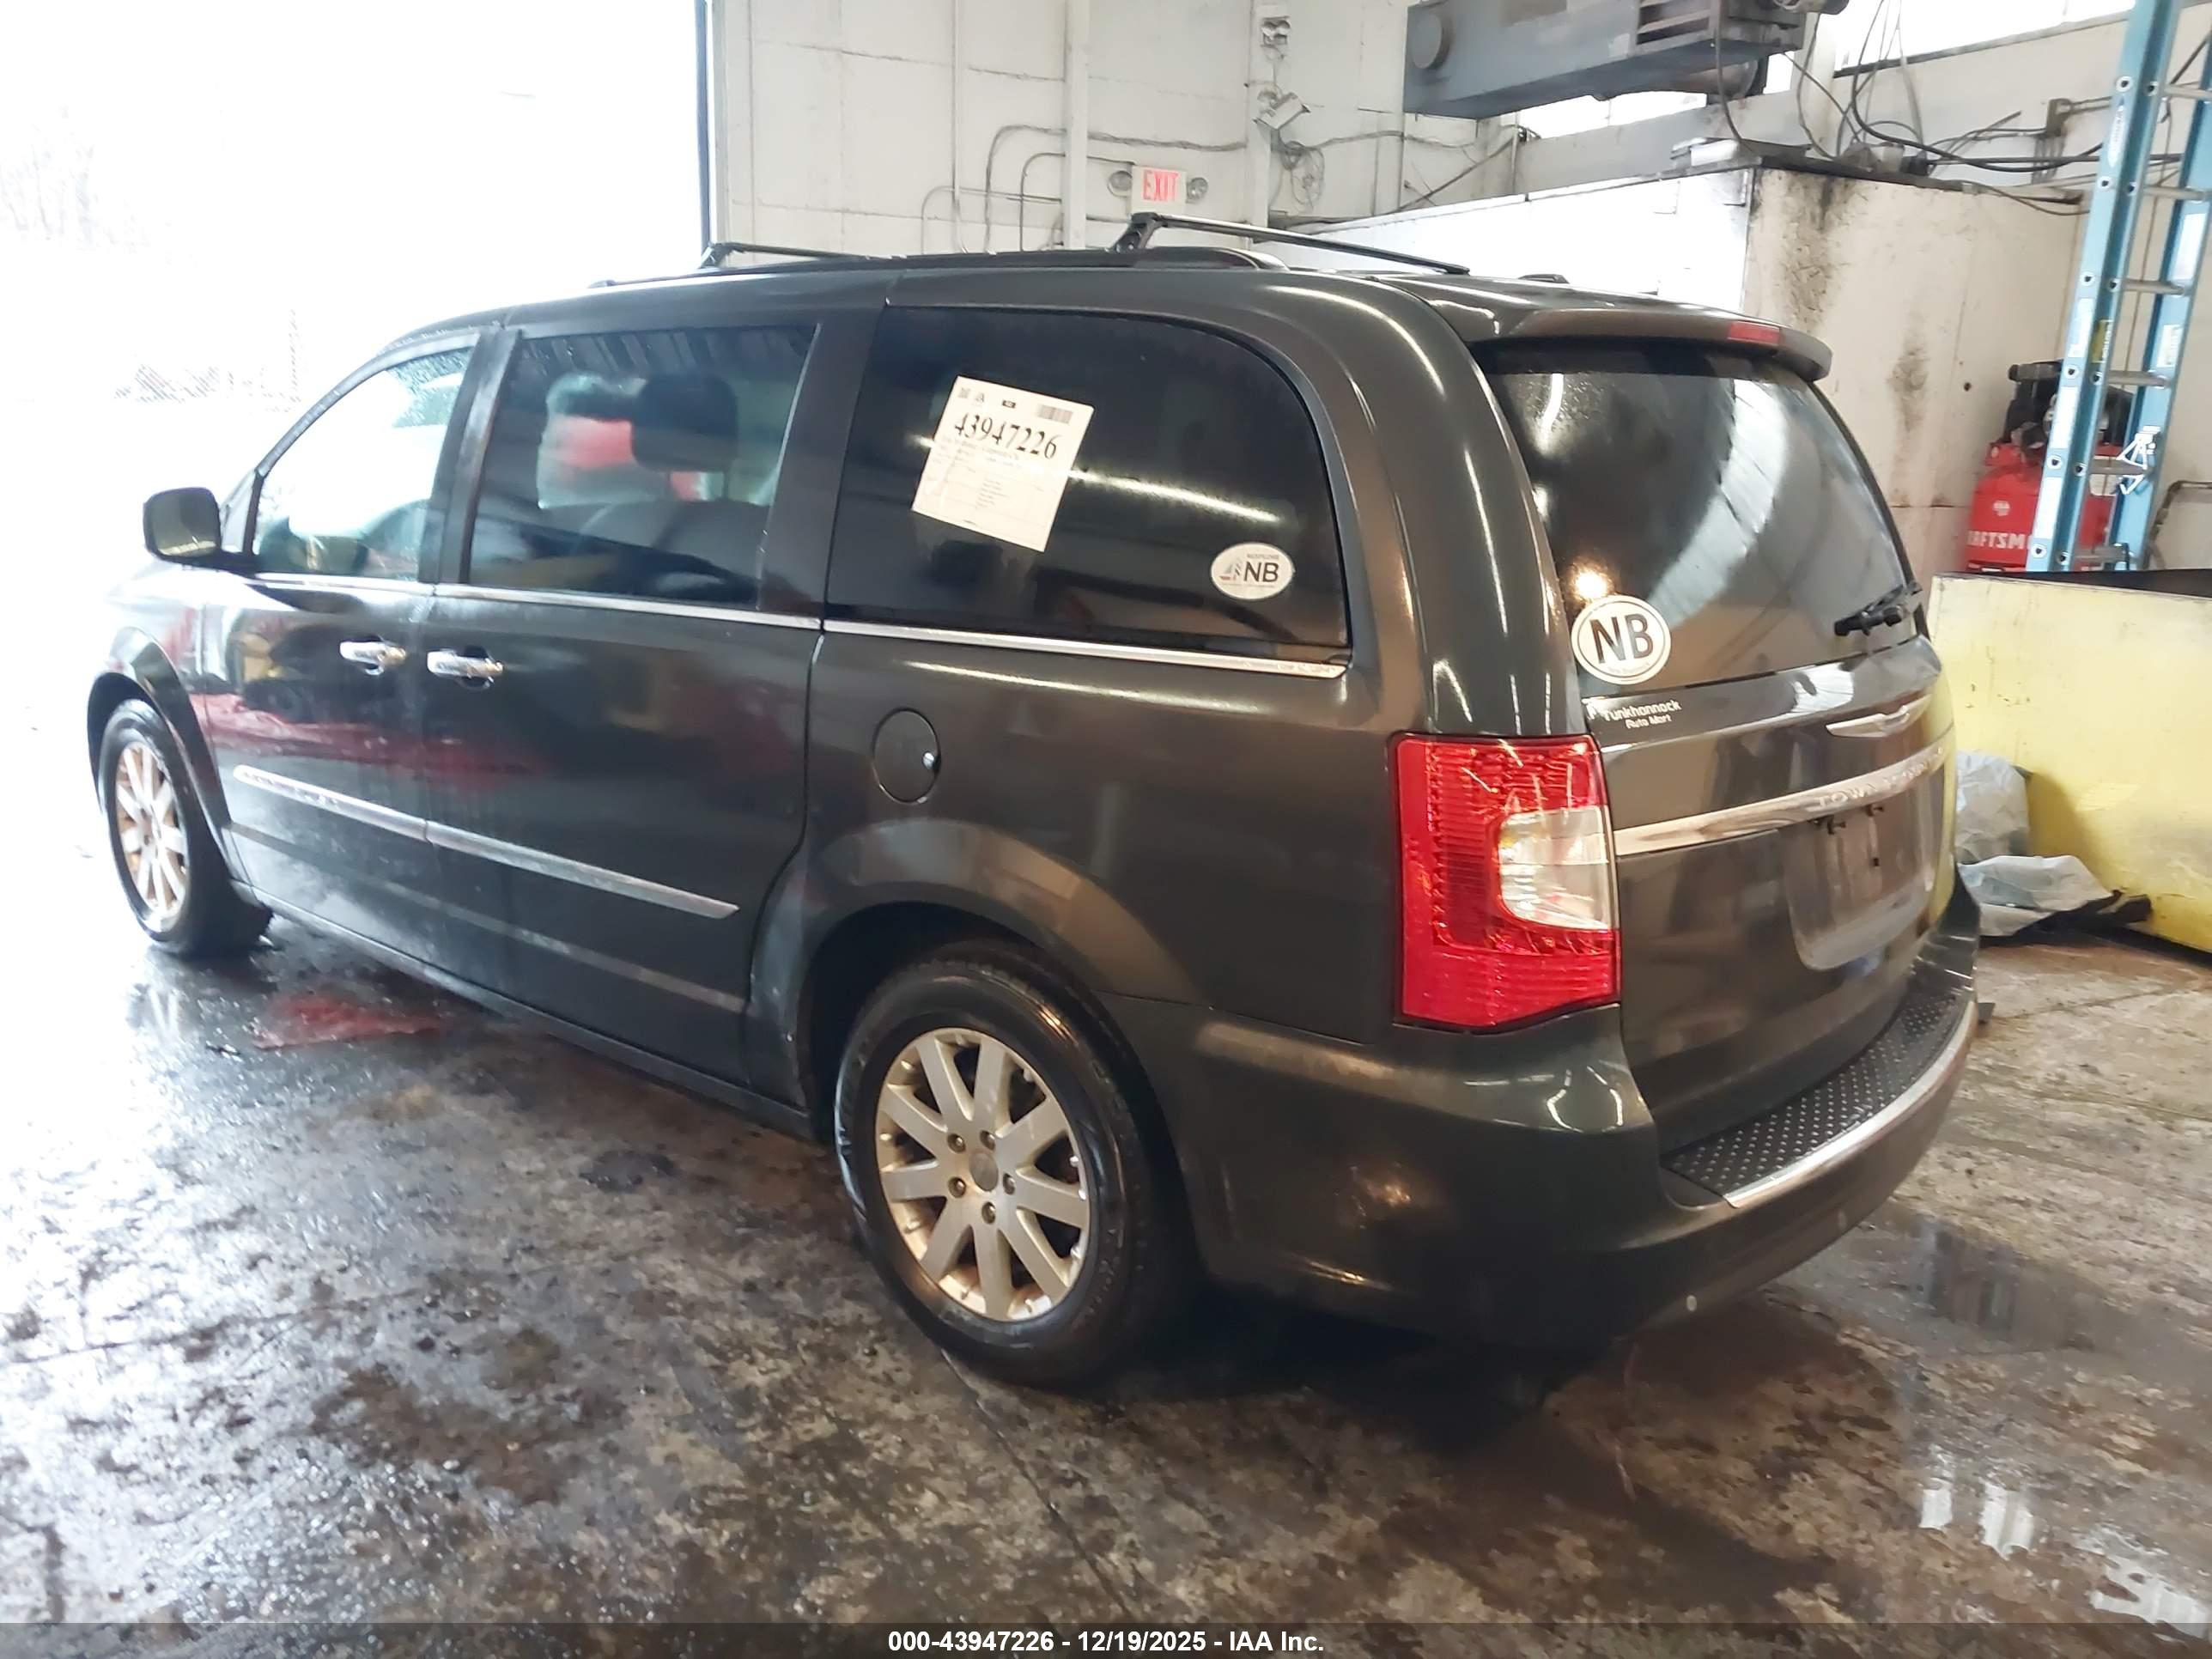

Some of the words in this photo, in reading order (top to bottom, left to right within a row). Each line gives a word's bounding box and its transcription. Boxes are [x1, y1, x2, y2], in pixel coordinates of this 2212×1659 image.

[1143, 168, 1179, 202] EXIT
[954, 412, 1062, 459] 43947226
[1243, 561, 1279, 582] NB
[1590, 613, 1654, 664] NB
